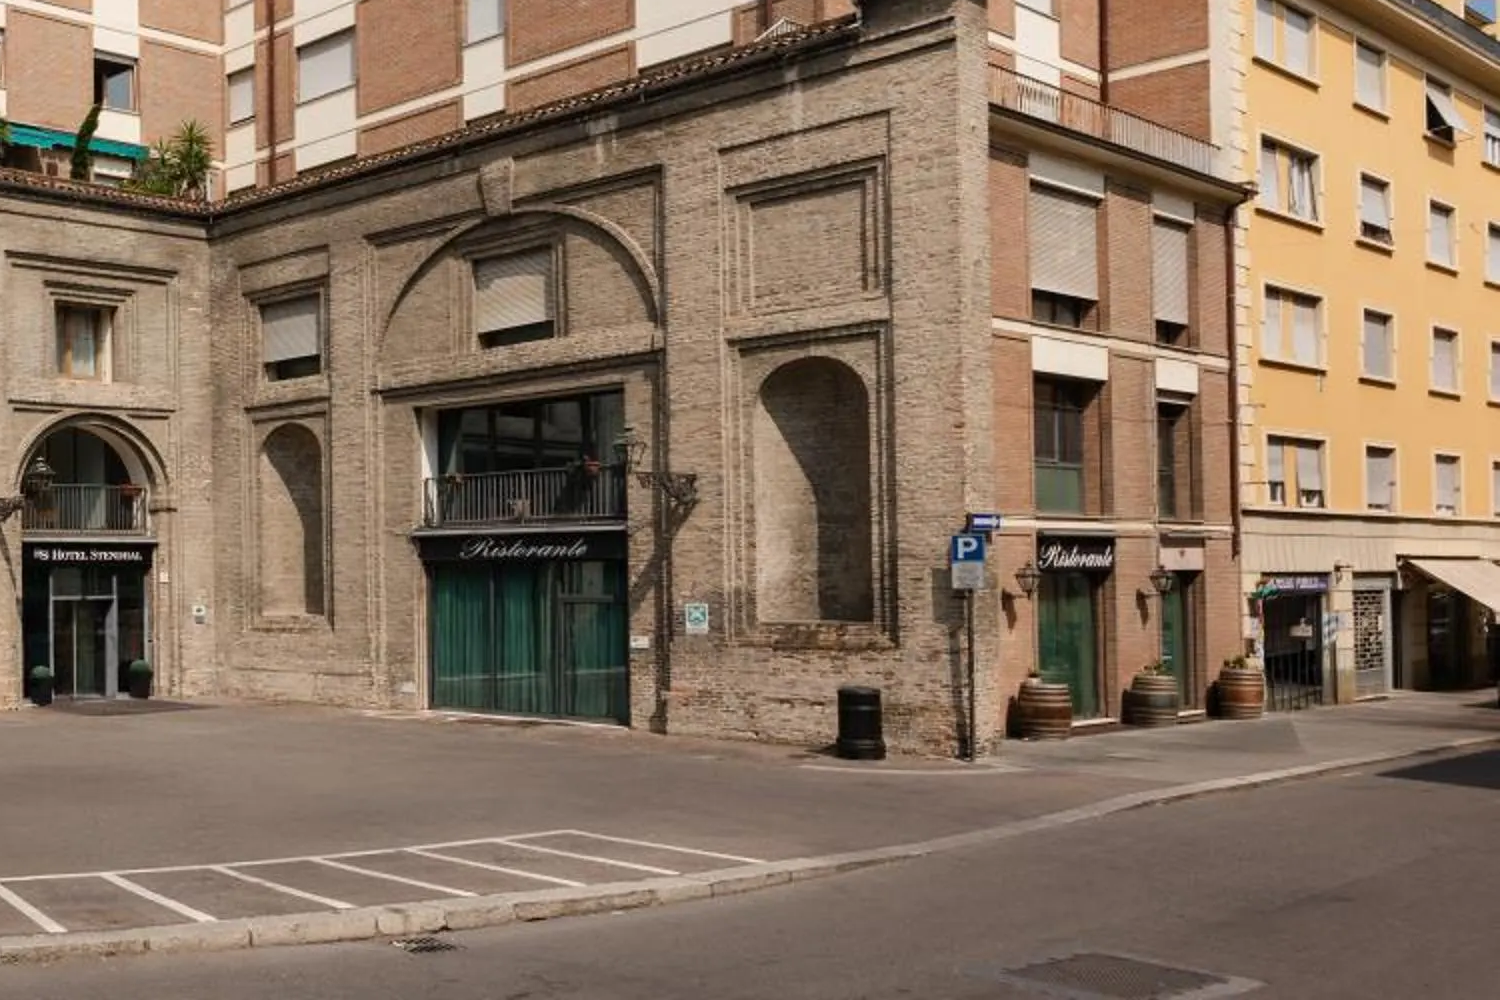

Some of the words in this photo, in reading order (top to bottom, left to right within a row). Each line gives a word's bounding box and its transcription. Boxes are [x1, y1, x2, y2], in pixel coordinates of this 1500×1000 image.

[52, 549, 88, 560] HOTEL
[459, 537, 588, 560] Ristorante
[957, 537, 978, 559] P
[1039, 541, 1113, 568] Ristorante
